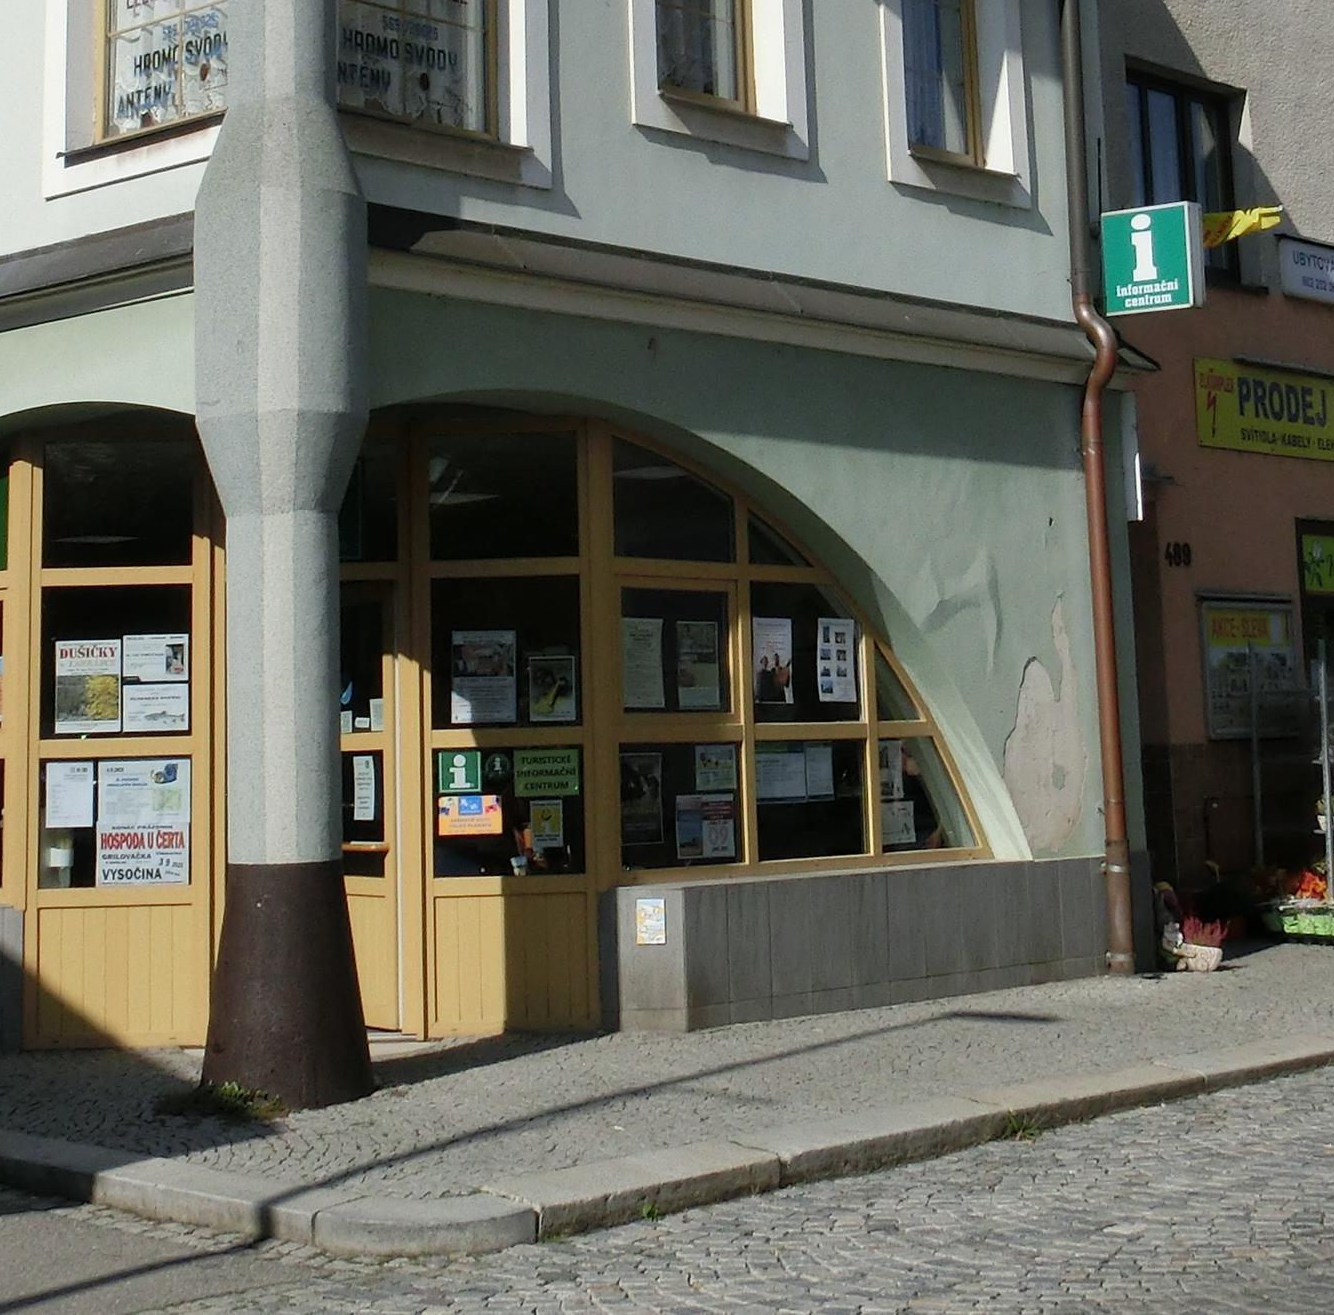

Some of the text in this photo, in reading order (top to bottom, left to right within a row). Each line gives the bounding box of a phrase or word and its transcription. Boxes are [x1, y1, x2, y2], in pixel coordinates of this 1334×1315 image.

[1124, 293, 1173, 308] centrum
[1237, 376, 1328, 428] PRODEJ
[59, 645, 118, 660] DUŠIČKY
[516, 766, 576, 777] INFORMAČNÍ
[524, 781, 570, 790] CENTRUM
[100, 829, 185, 850] HOSPODA U ČERTA
[102, 867, 162, 881] VYSOČINA
